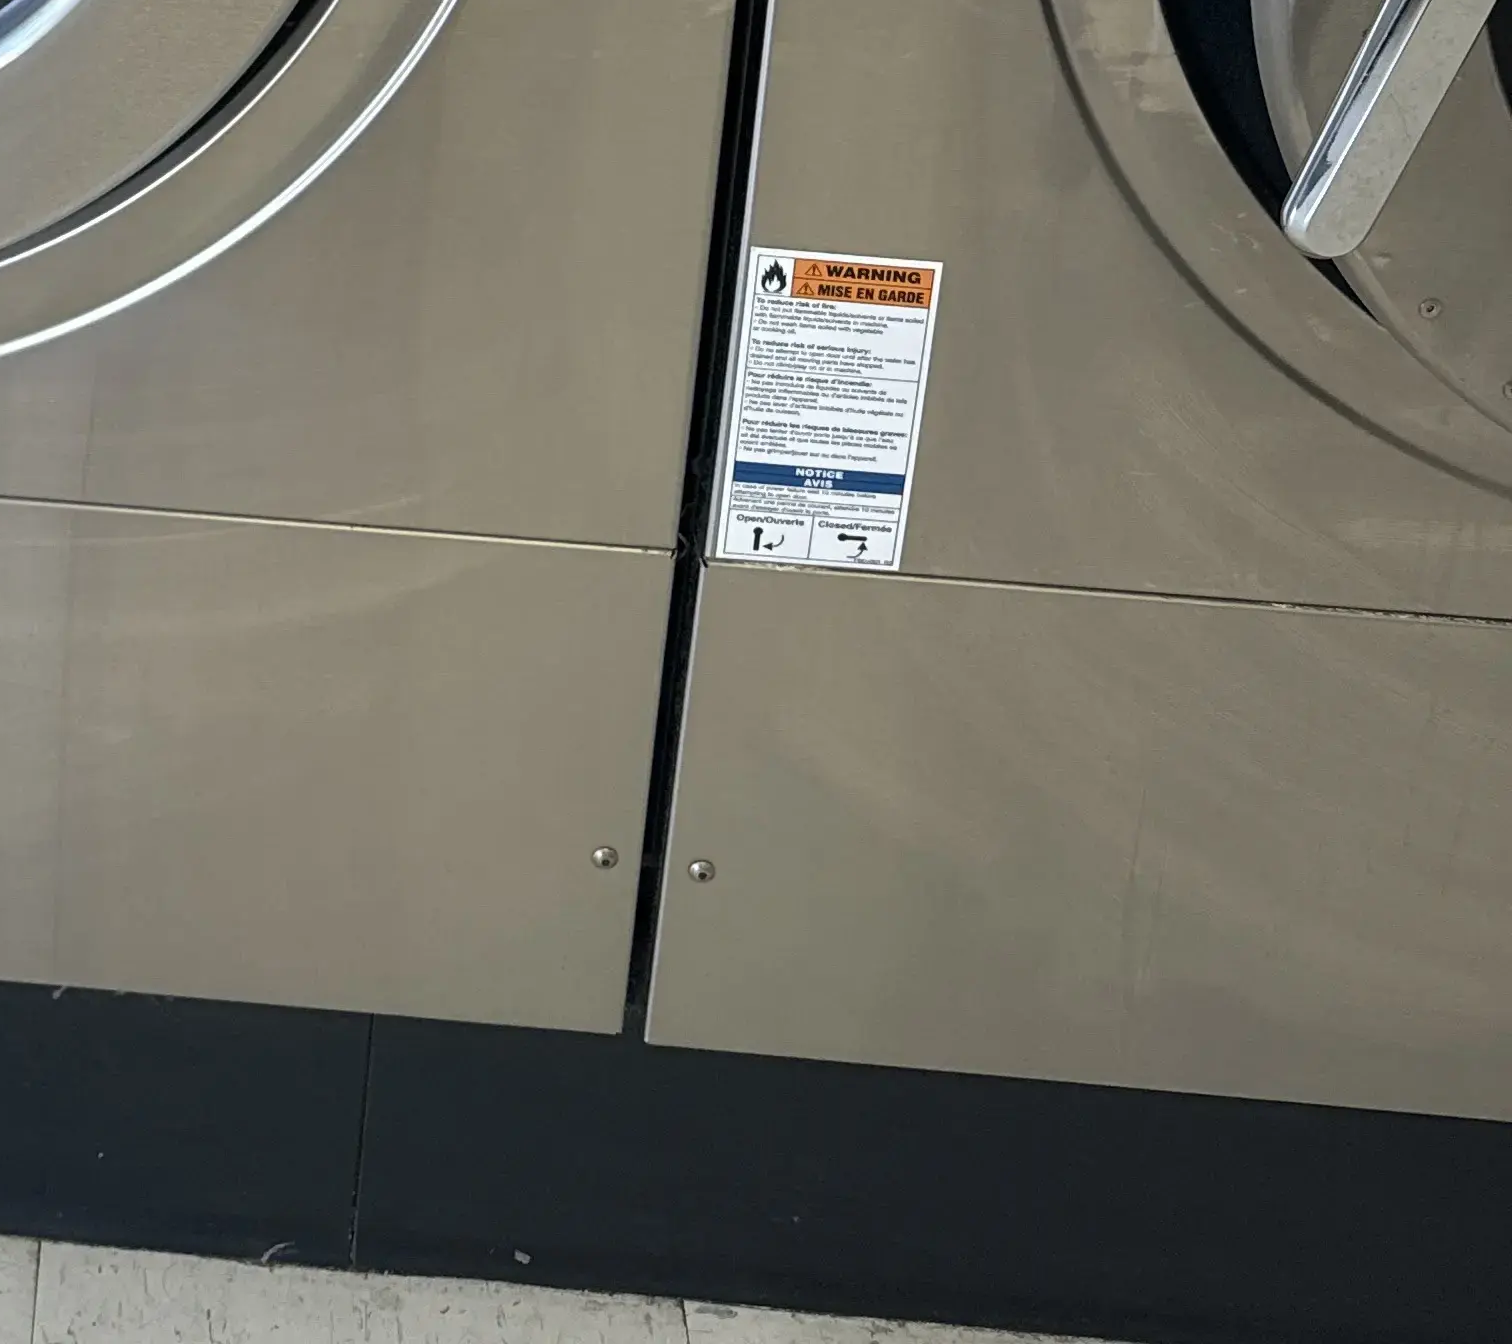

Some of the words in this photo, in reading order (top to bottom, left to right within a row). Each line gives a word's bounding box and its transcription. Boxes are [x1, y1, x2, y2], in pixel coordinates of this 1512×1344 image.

[826, 265, 921, 284] WARNING
[817, 284, 853, 299] MISE
[856, 287, 875, 300] EN
[878, 289, 925, 305] GARDE
[795, 468, 844, 480] NOTICE
[804, 478, 833, 488] AVIS
